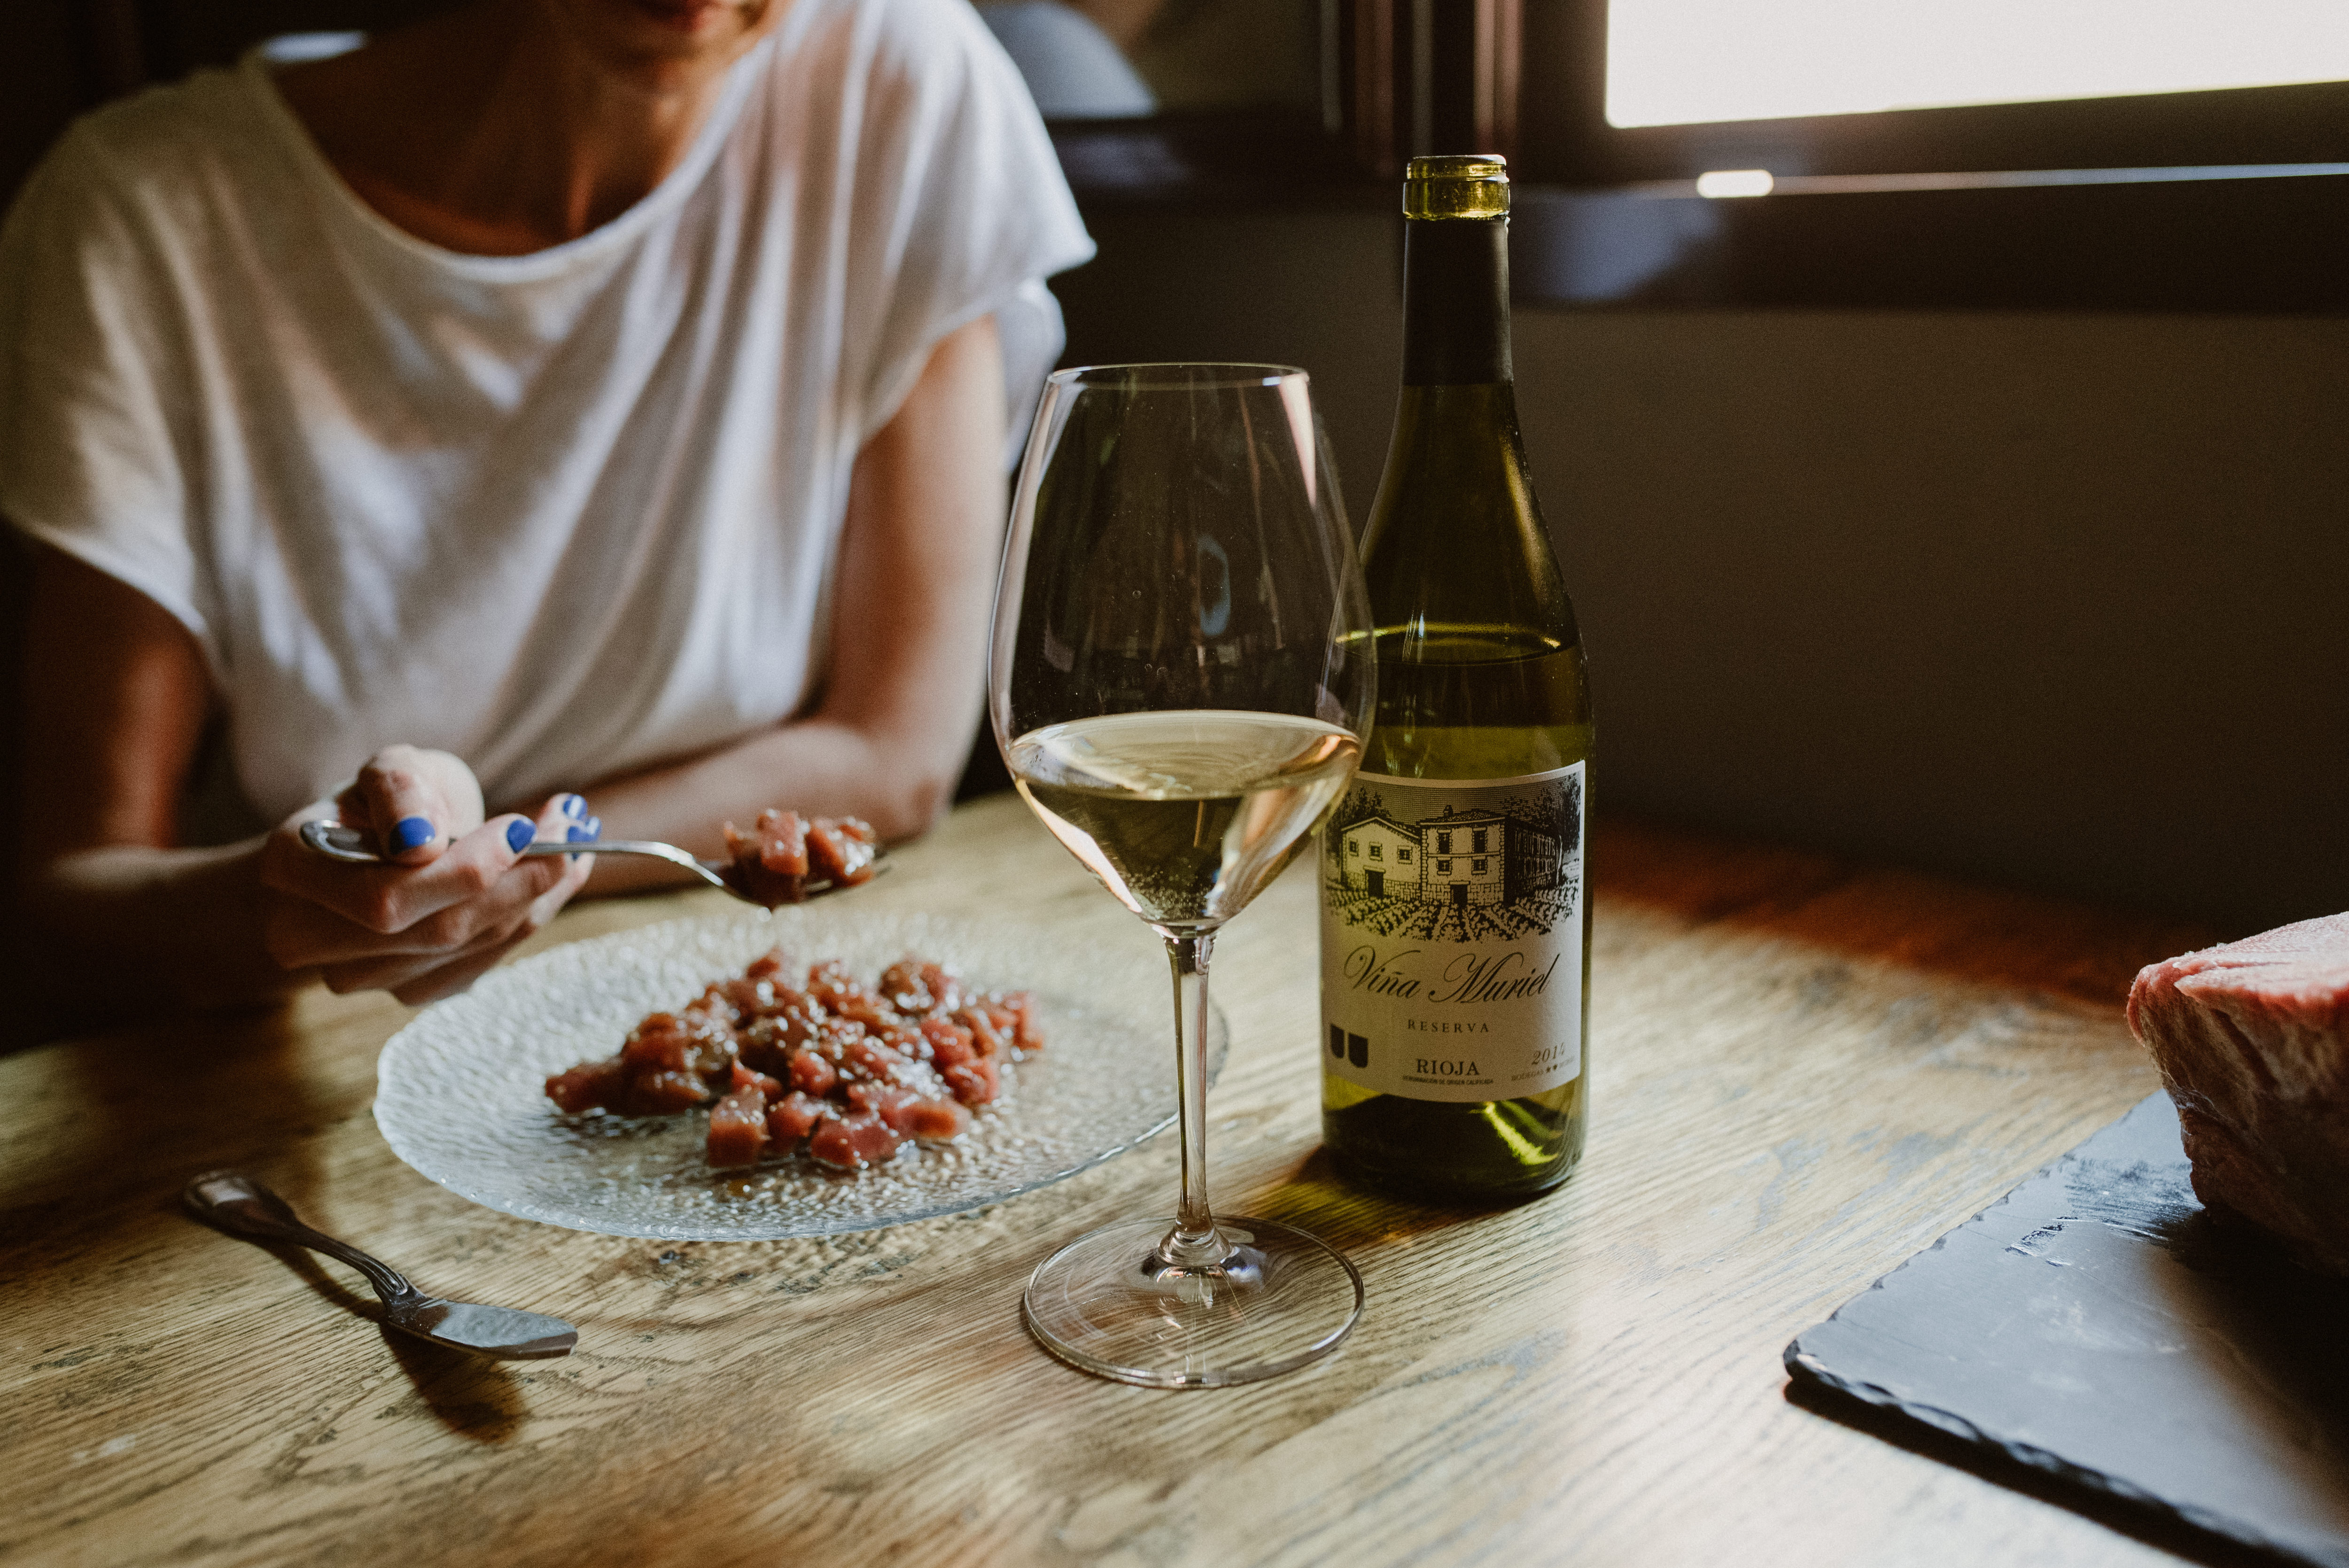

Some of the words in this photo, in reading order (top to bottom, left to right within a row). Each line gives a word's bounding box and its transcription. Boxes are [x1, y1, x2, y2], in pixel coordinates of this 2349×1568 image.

[1343, 945, 1421, 999] Viña
[1428, 952, 1560, 1004] Muriel
[1408, 1018, 1489, 1033] RESERVA
[1416, 1058, 1479, 1076] RIOJA
